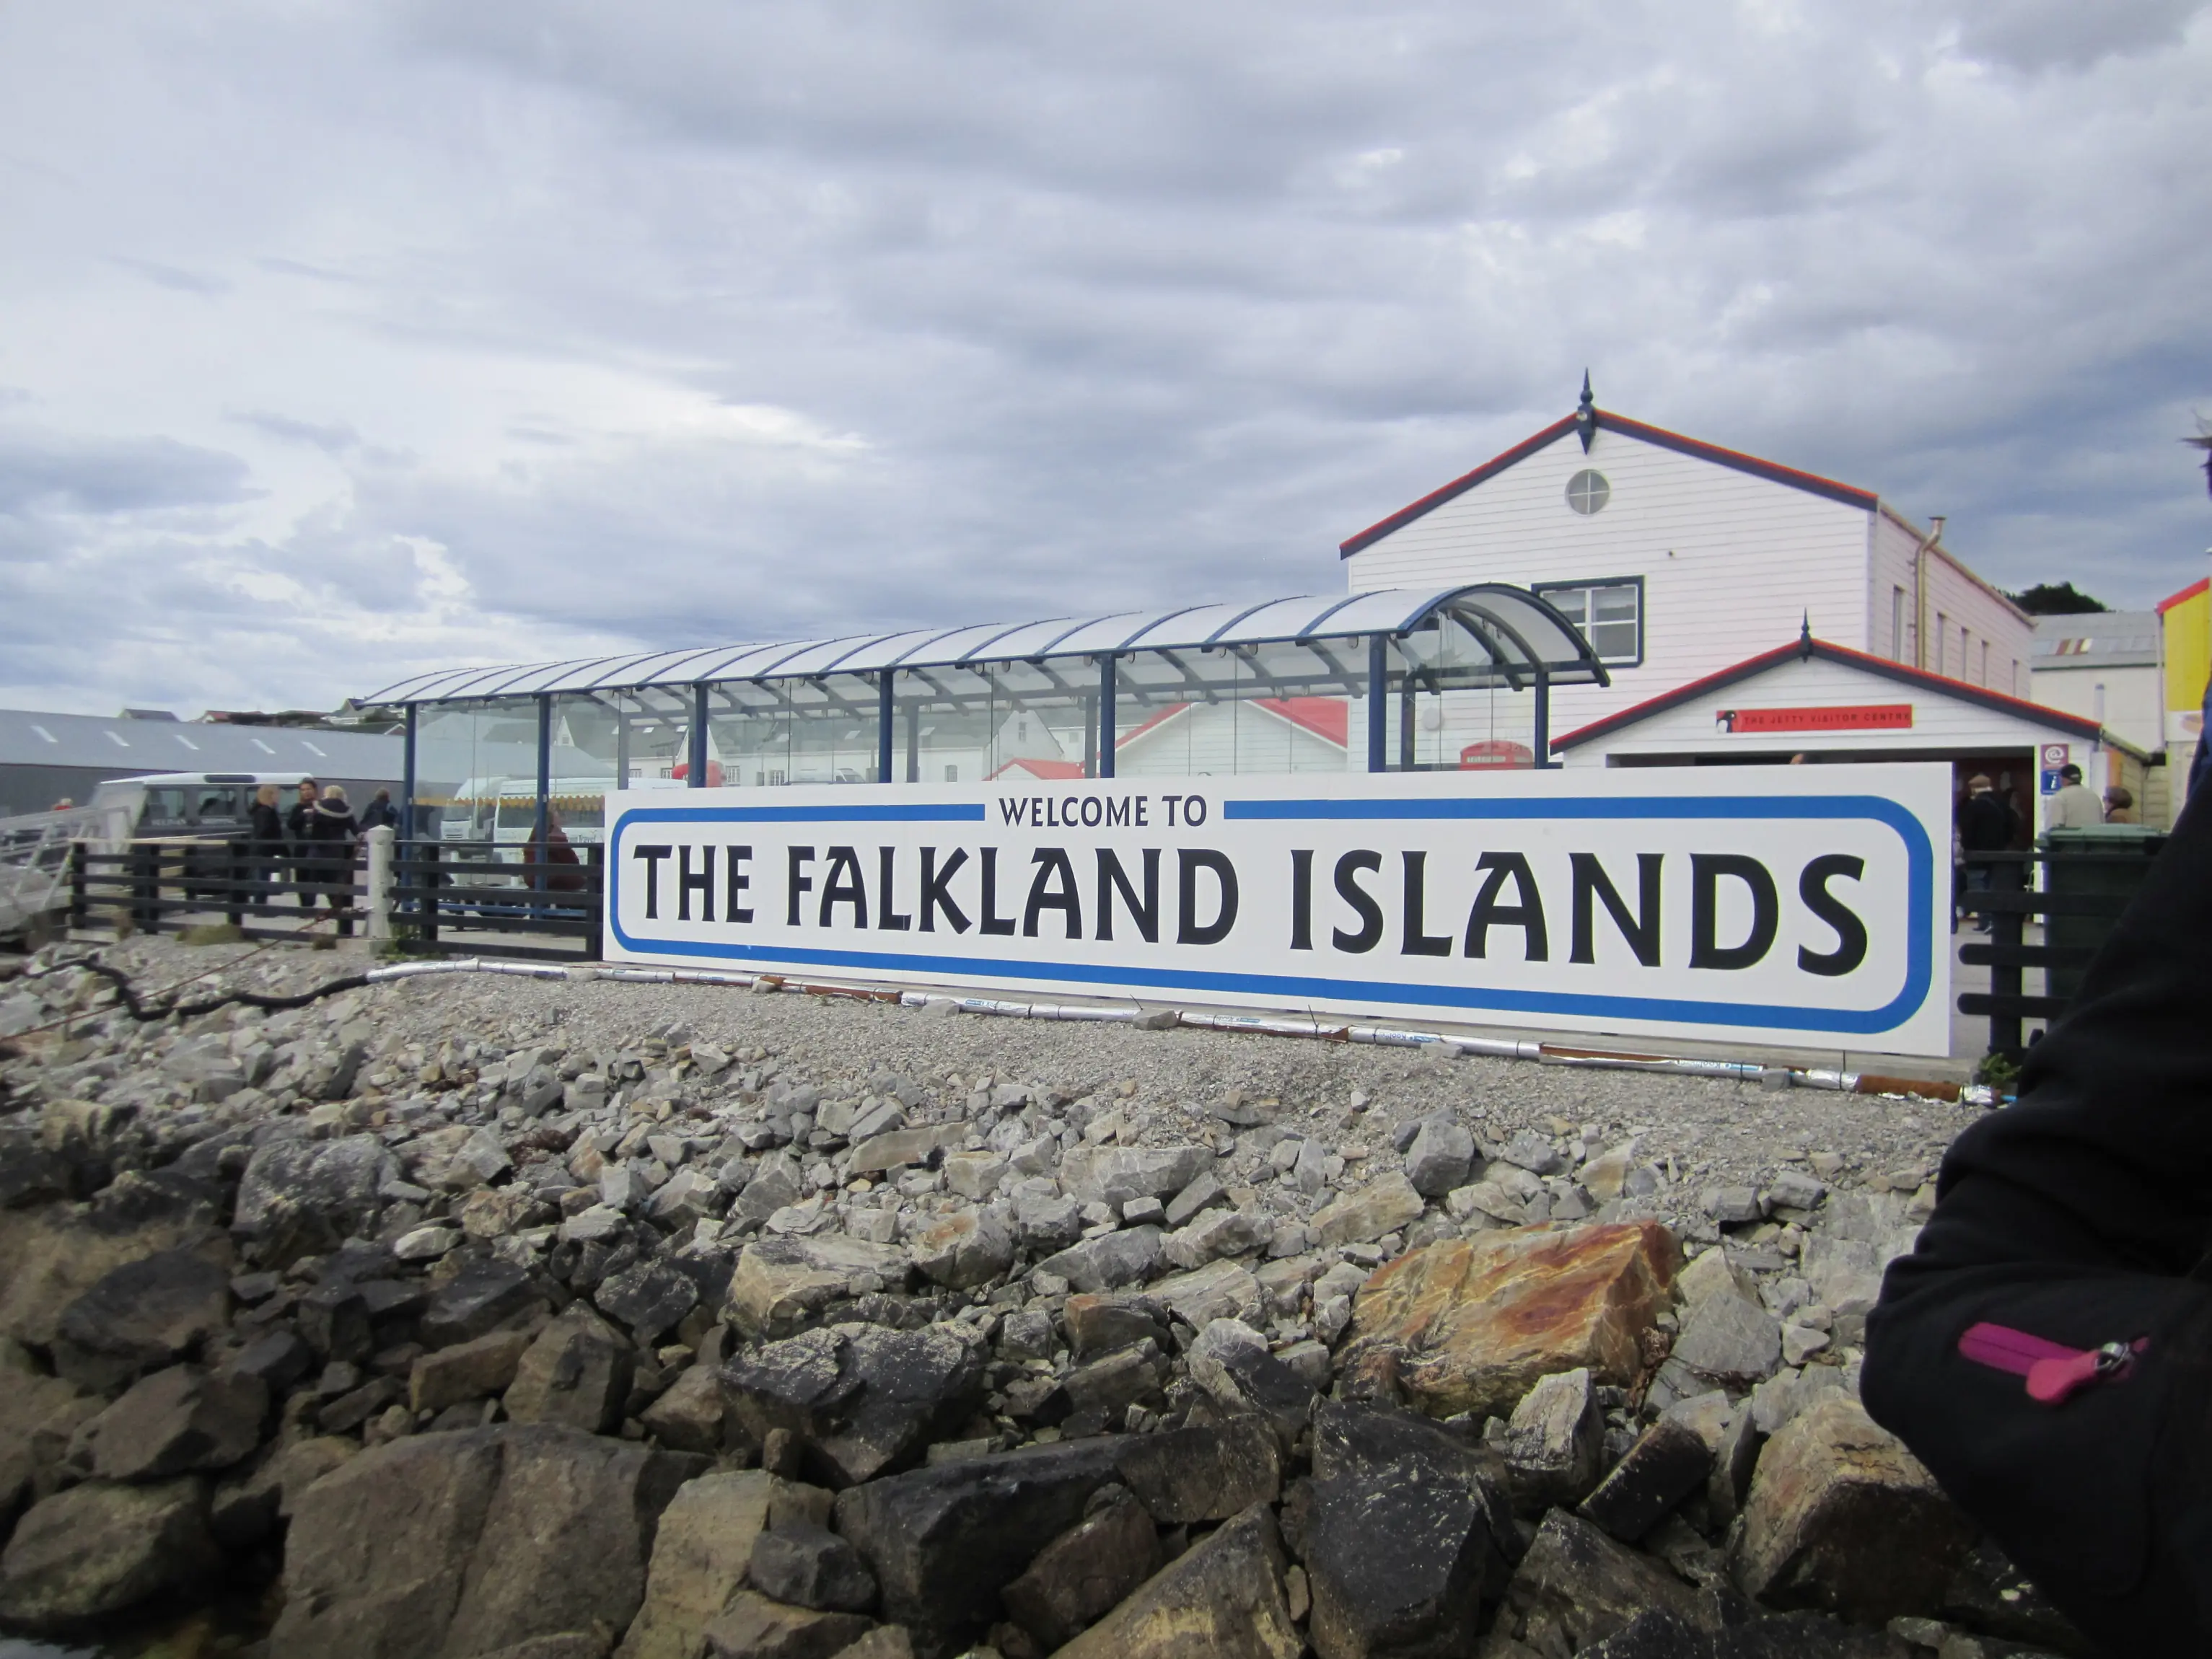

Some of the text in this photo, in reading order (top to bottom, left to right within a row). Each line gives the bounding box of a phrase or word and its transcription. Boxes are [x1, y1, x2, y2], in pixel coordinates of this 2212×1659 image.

[1744, 711, 1910, 725] THE JETTY VISITOR CENTRE
[999, 795, 1207, 827] WELCOME TO
[633, 845, 1868, 977] THE FALKLAND ISLANDS
